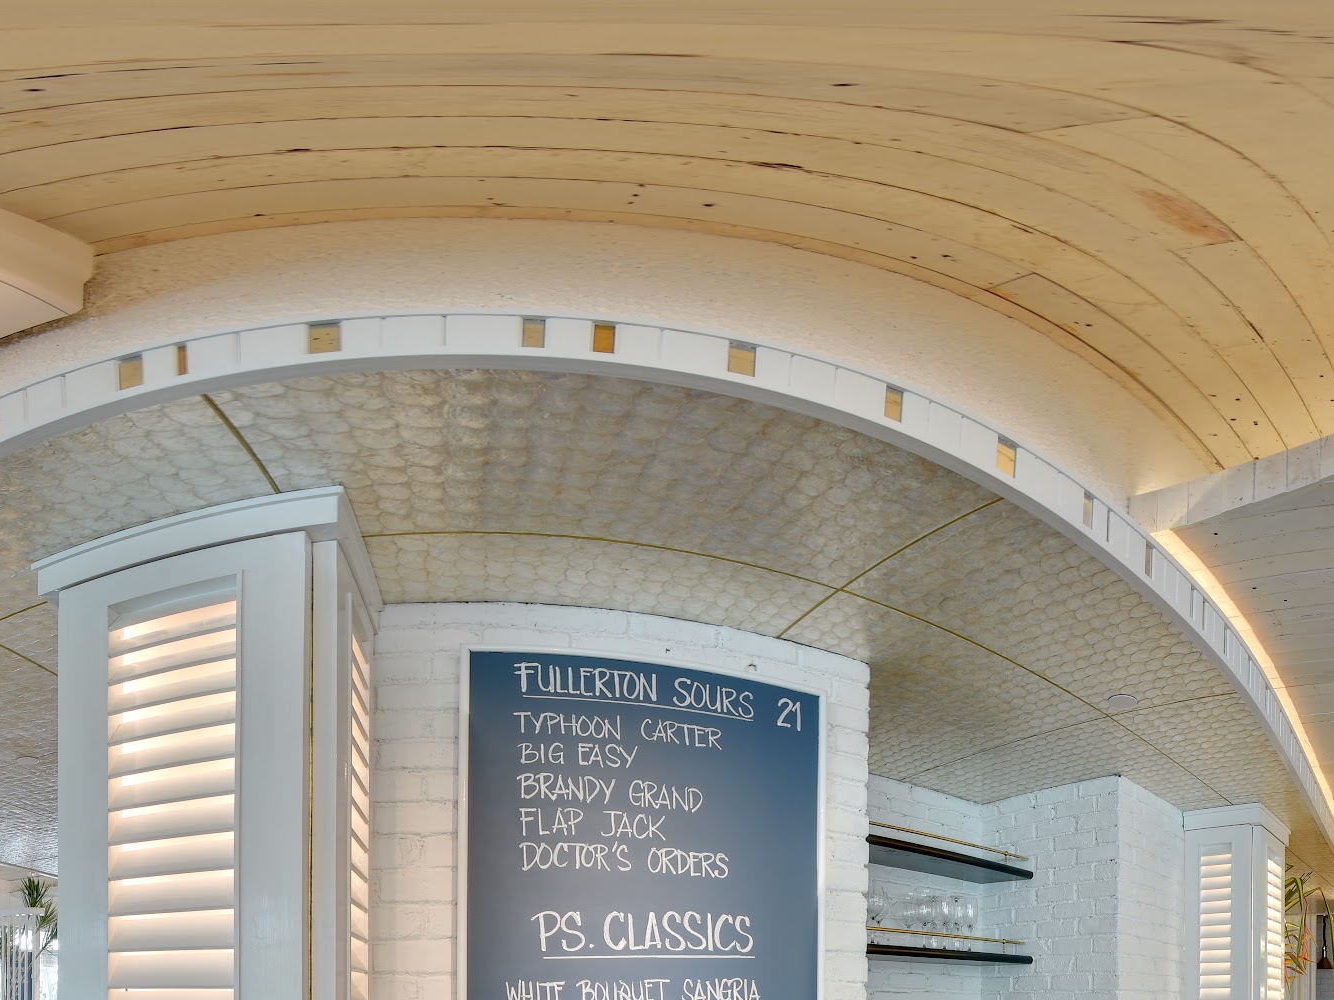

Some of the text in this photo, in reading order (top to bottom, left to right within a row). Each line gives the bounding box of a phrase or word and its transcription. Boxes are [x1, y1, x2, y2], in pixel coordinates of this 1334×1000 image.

[514, 662, 802, 732] FULLERTON SOURS 21
[513, 712, 722, 750] TYPHOON CARTER
[517, 743, 638, 768] BIG EASY
[517, 773, 702, 813] BRANDY GRAND
[519, 808, 665, 841] FLAP JACK
[519, 841, 728, 878] DOCTOR'S ORDERS
[531, 911, 753, 953] PS. CLASSICS
